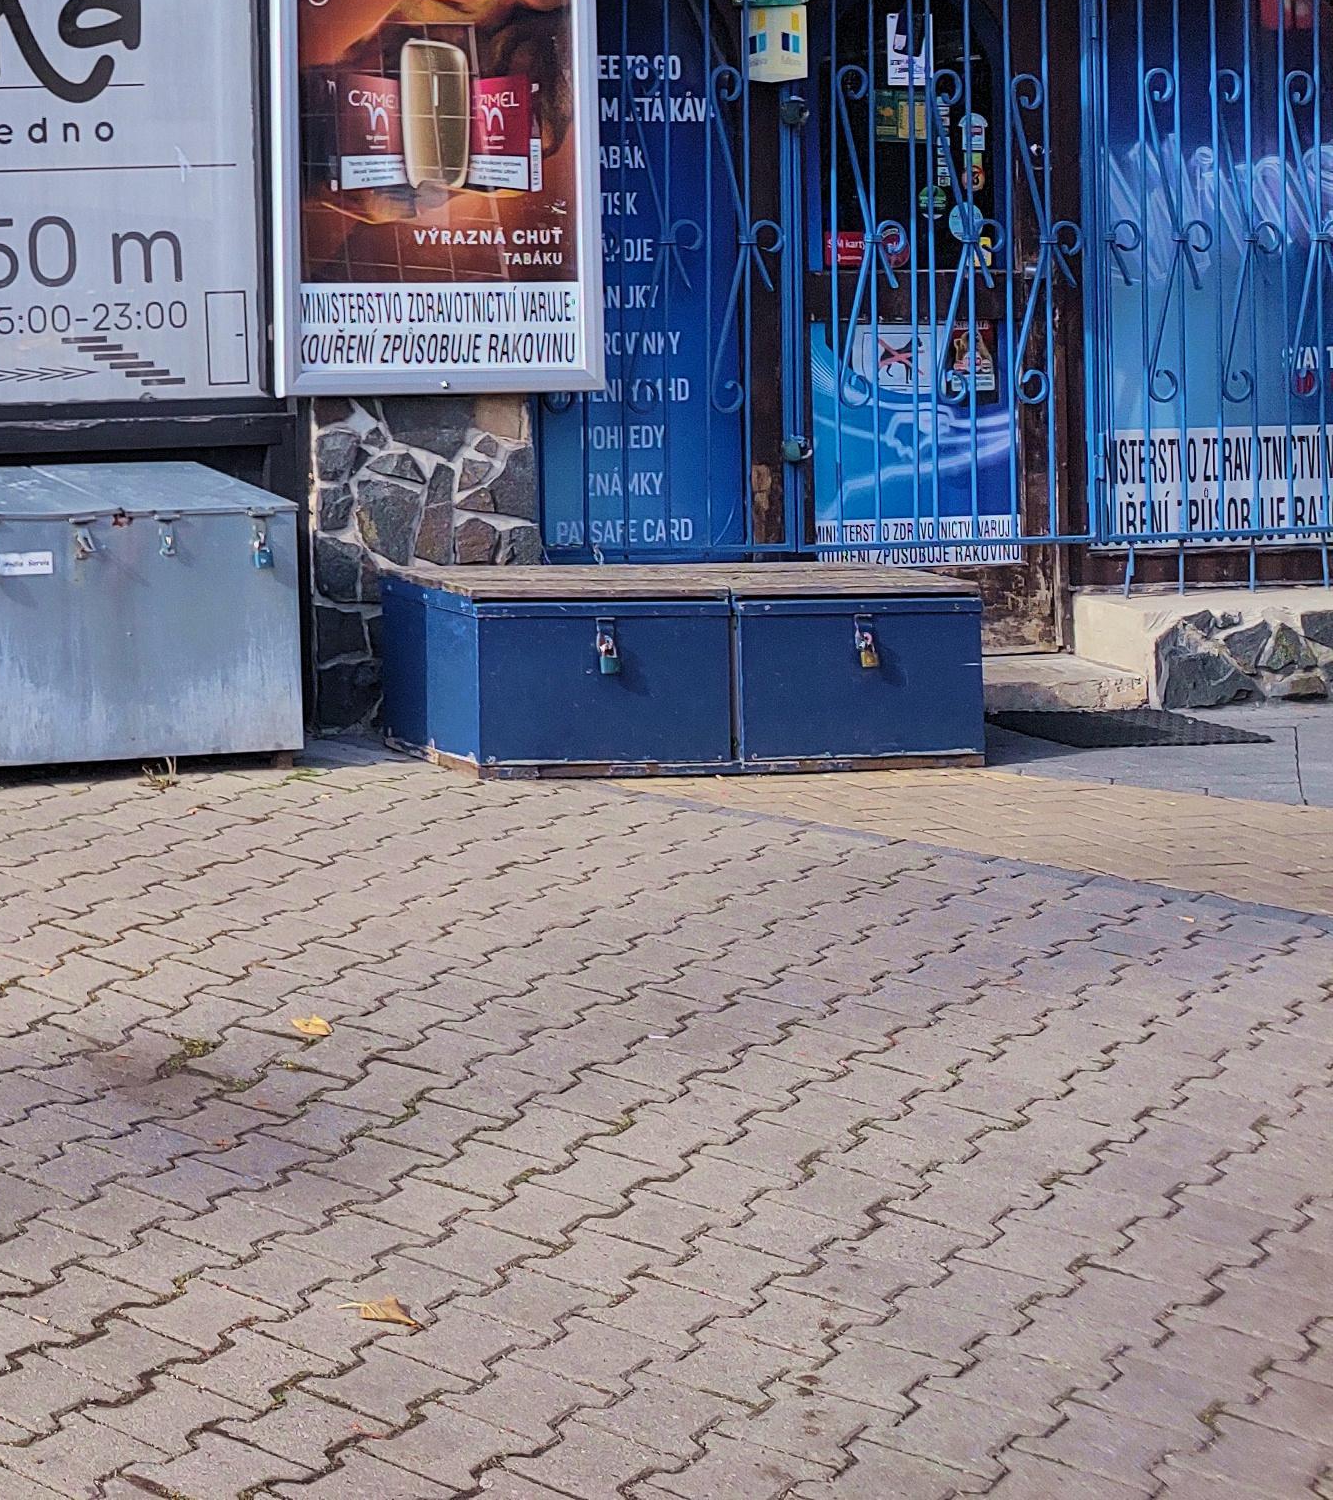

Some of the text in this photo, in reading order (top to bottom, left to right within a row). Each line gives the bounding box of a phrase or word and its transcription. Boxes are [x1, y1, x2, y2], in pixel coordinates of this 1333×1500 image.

[669, 91, 715, 121] KÁV
[599, 140, 645, 168] ABÁK
[413, 227, 563, 245] VÝRAZNÁ CHUŤ
[111, 231, 183, 284] m
[503, 251, 563, 266] TABÁKU
[300, 292, 402, 324] MINISTERSTVO
[408, 286, 517, 323] ZDRAVOTNICTVÍ
[382, 327, 482, 364] ZPŮSOBUJE
[488, 332, 576, 364] RAKOVINU
[643, 518, 692, 543] CARD
